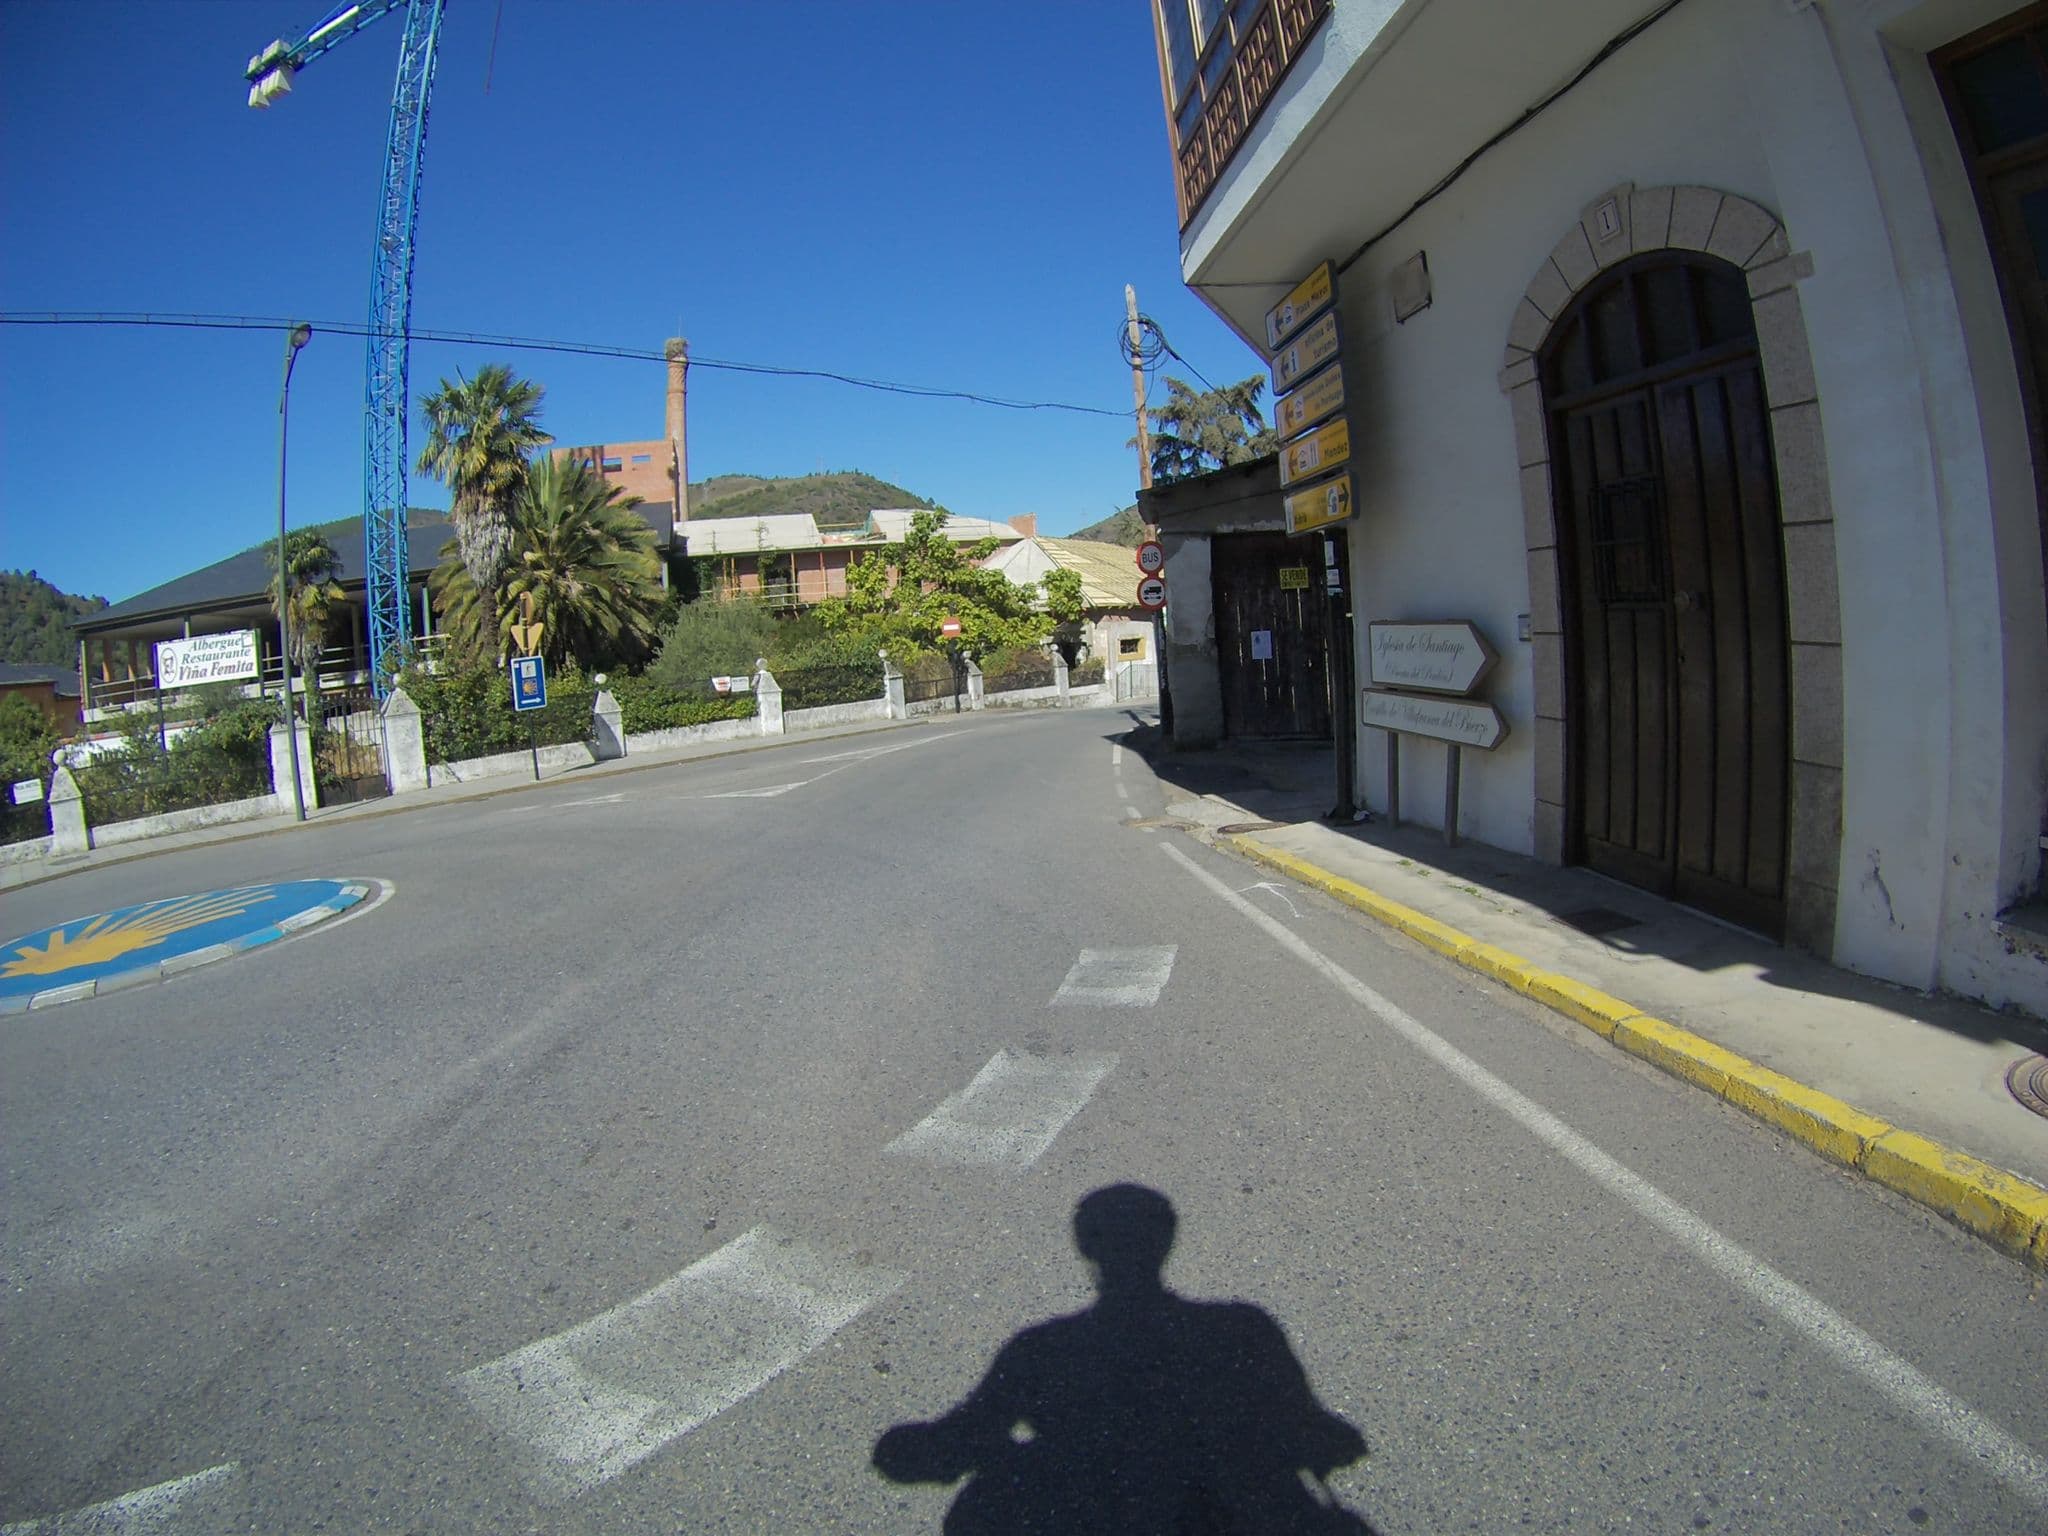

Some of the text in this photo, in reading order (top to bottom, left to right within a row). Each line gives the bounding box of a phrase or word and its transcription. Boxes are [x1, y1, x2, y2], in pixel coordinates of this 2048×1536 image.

[1142, 551, 1159, 563] BUS
[189, 637, 240, 651] Albergue
[1374, 631, 1465, 662] Iglesia de Santiago
[181, 648, 252, 665] Restaurante
[179, 665, 208, 681] Viña
[1441, 707, 1454, 728] del
